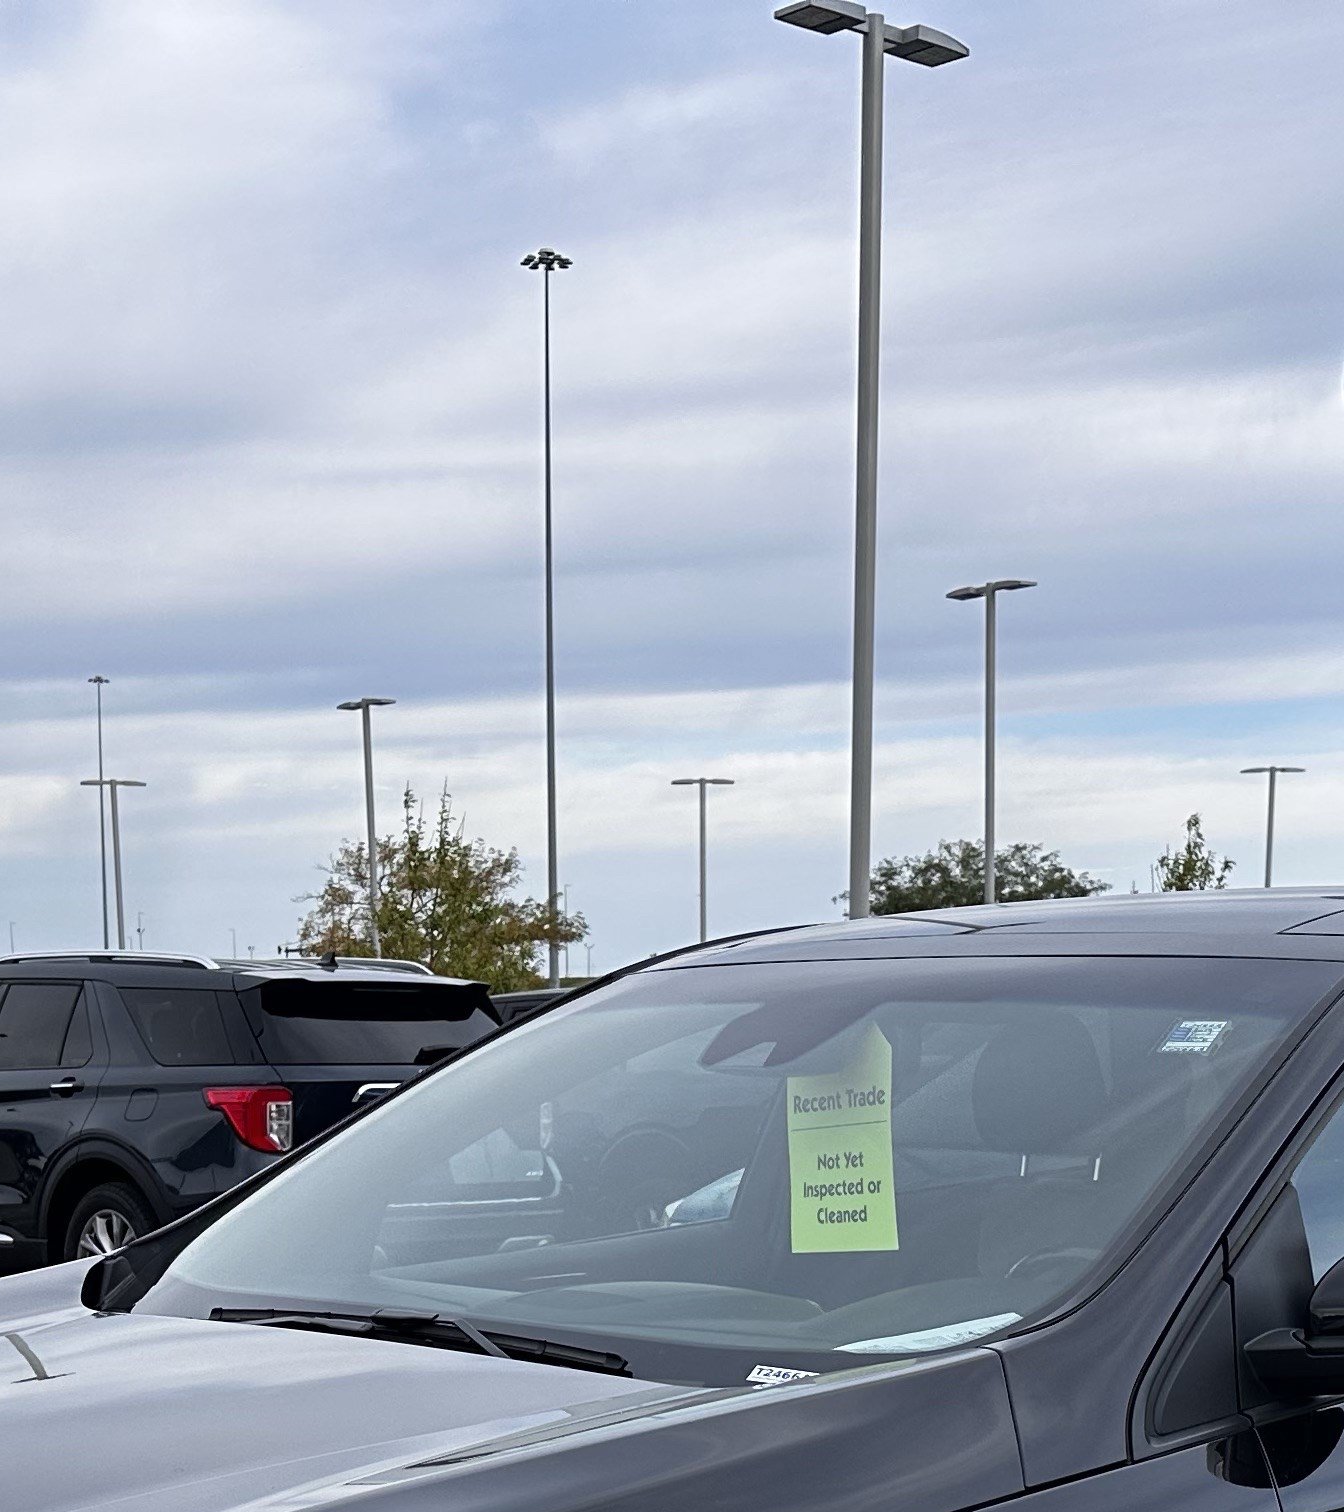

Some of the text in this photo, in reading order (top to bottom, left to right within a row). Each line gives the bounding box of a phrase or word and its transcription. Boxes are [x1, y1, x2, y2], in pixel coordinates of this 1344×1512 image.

[793, 1085, 886, 1114] Recent Trade
[817, 1151, 864, 1170] Not Yet
[803, 1177, 882, 1201] Inspected or
[817, 1205, 868, 1224] Cleaned
